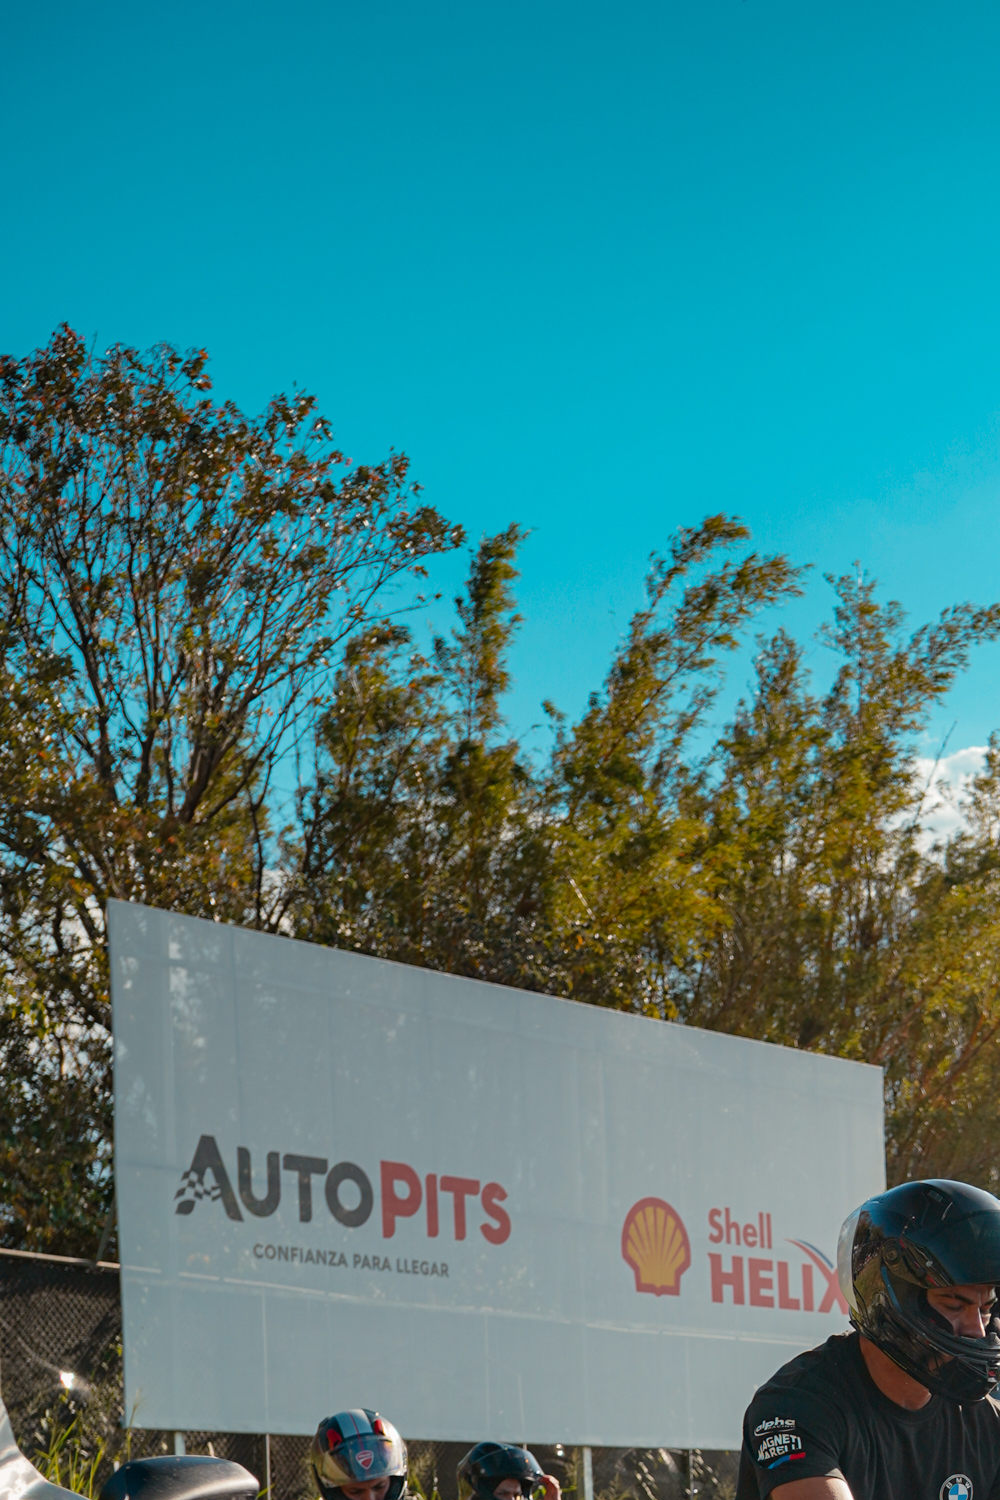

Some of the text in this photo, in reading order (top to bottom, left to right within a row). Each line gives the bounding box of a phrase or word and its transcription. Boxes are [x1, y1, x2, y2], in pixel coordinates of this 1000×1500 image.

[174, 1134, 511, 1245] AUTOPITS
[708, 1206, 772, 1249] Shell
[253, 1242, 449, 1278] CONFIANZA PARA LLEGAR
[707, 1251, 850, 1315] HELIX
[755, 1416, 796, 1433] alpha
[945, 1477, 972, 1490] BMW
